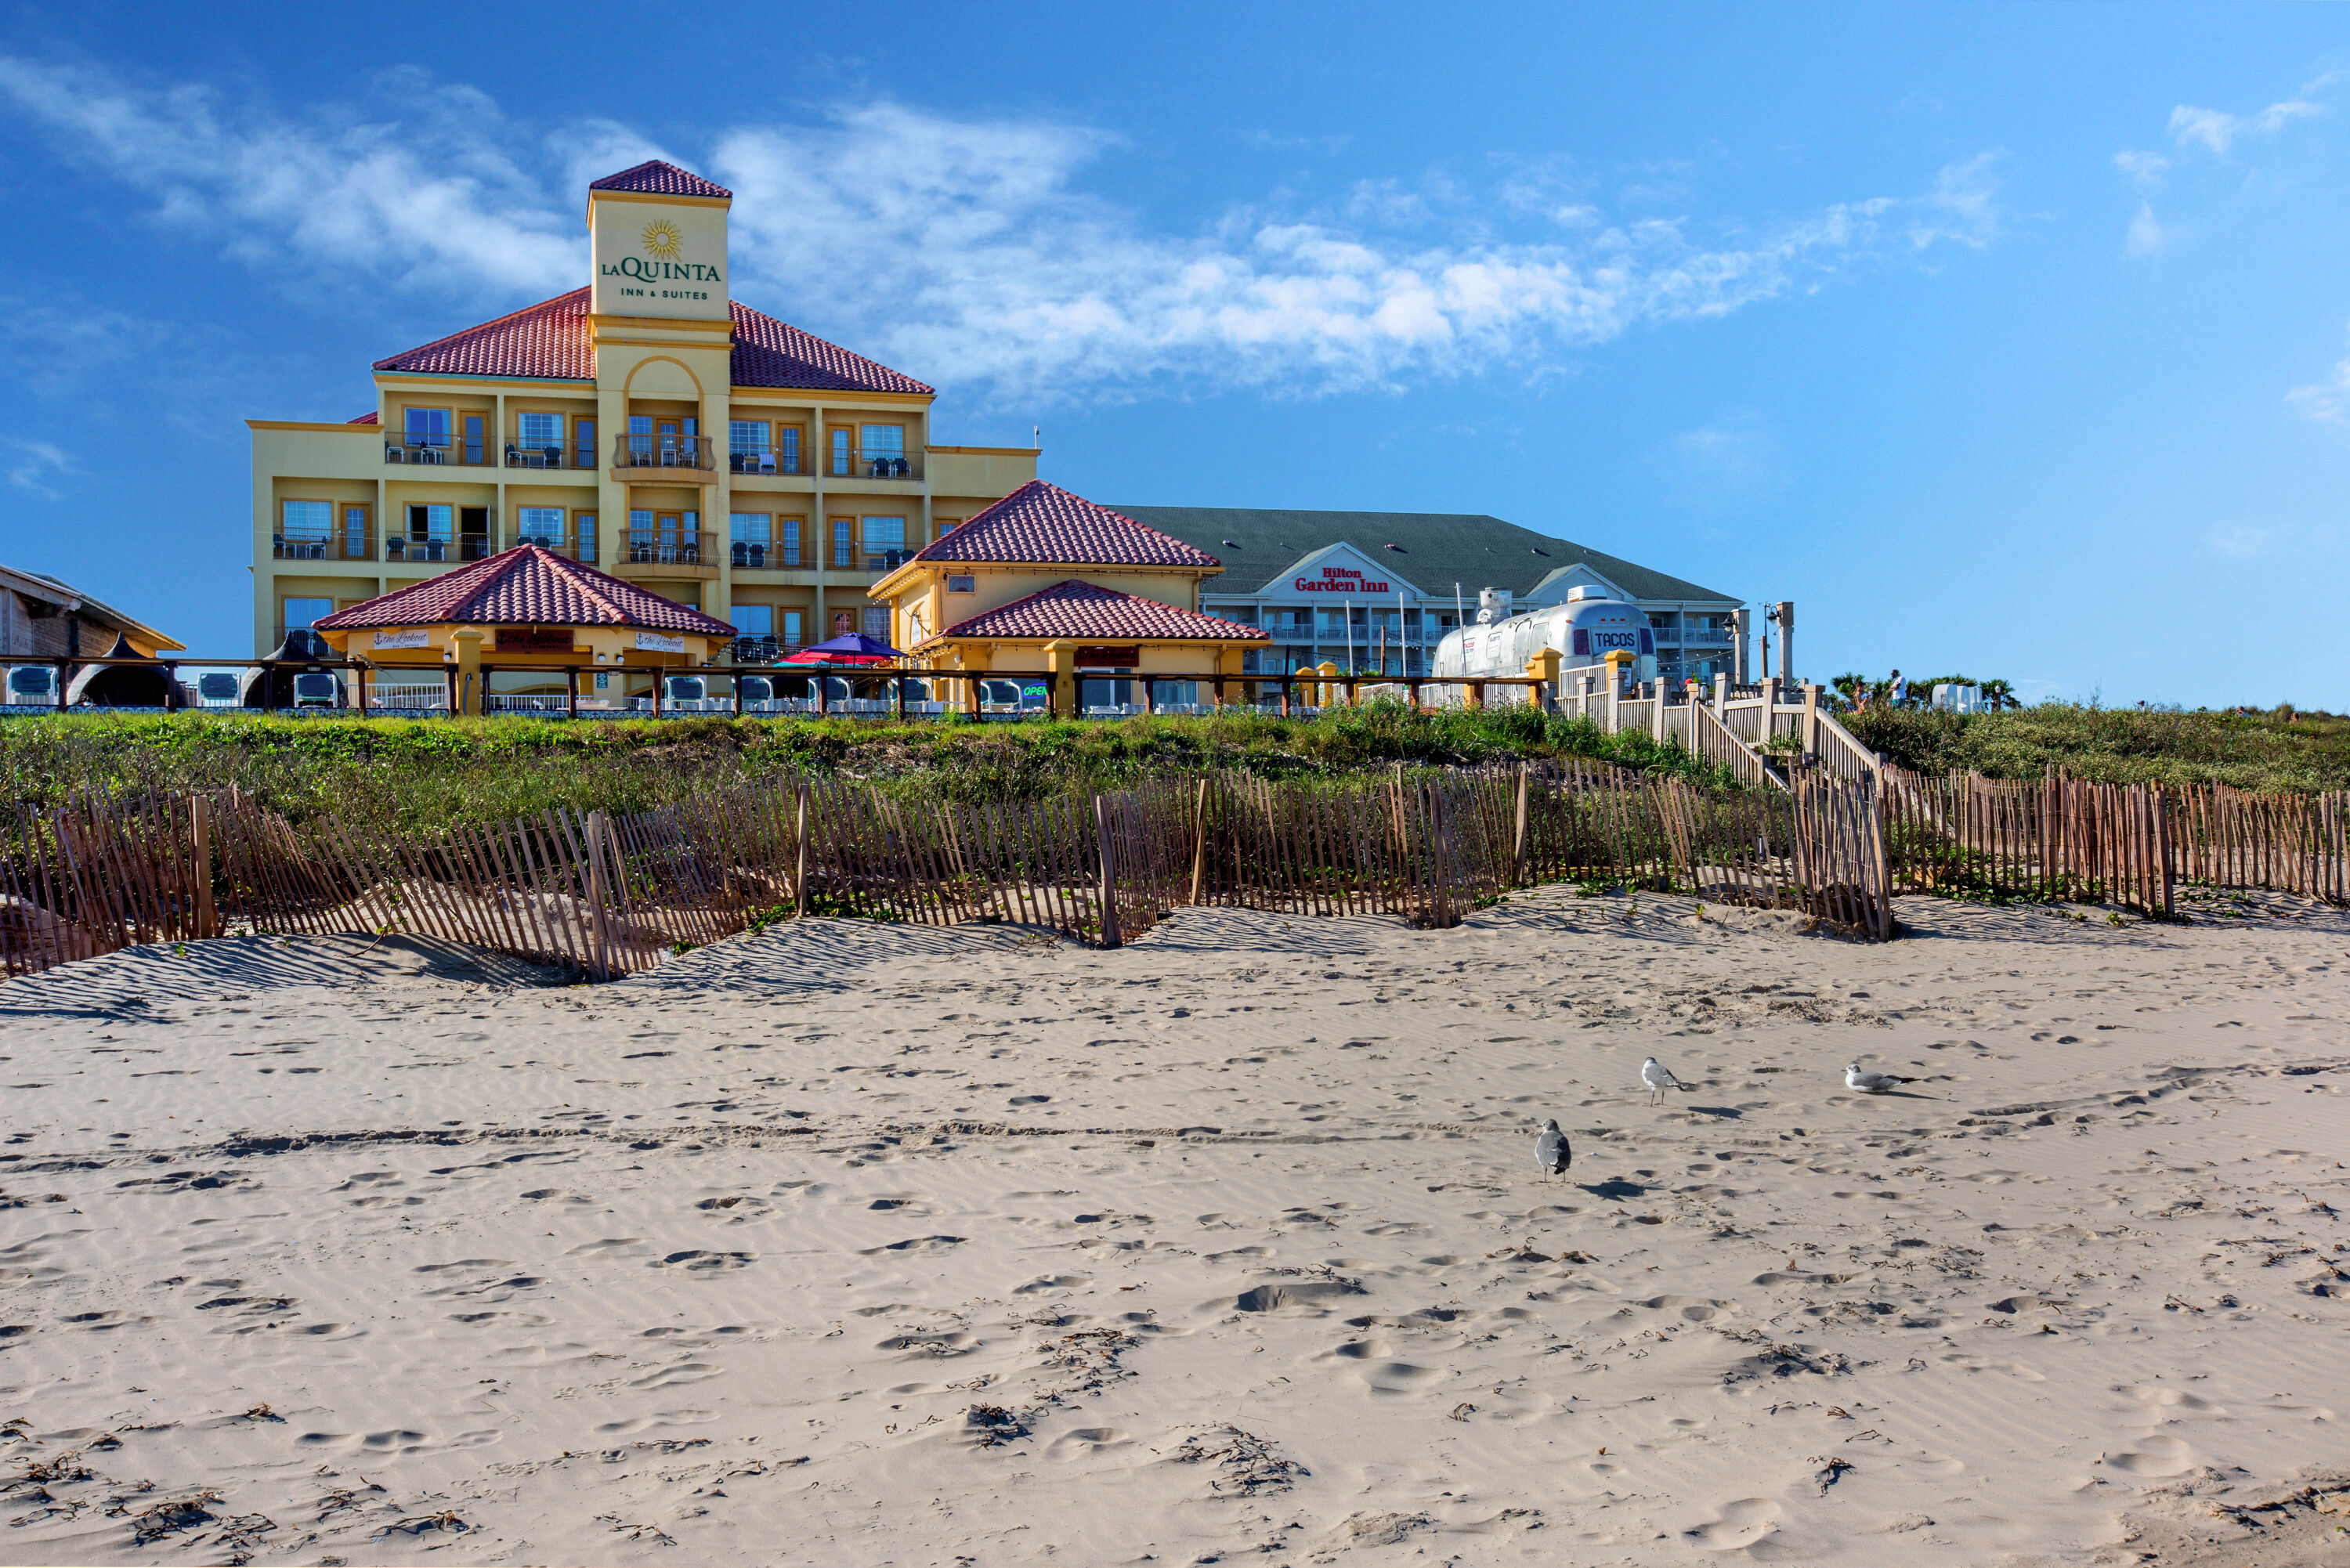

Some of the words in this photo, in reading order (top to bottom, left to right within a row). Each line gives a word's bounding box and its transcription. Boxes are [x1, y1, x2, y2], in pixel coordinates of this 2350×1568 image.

[621, 257, 721, 284] QUINTA
[621, 287, 644, 297] INN
[662, 290, 708, 300] SUITES
[1322, 567, 1362, 579] Hilton
[1295, 577, 1357, 592] Garden
[1360, 578, 1390, 593] Inn
[383, 634, 396, 643] the
[396, 630, 427, 644] Lookout
[644, 635, 655, 645] the
[656, 635, 684, 648] Lookout
[1595, 632, 1636, 647] TACOS
[1023, 685, 1047, 696] OPEN
